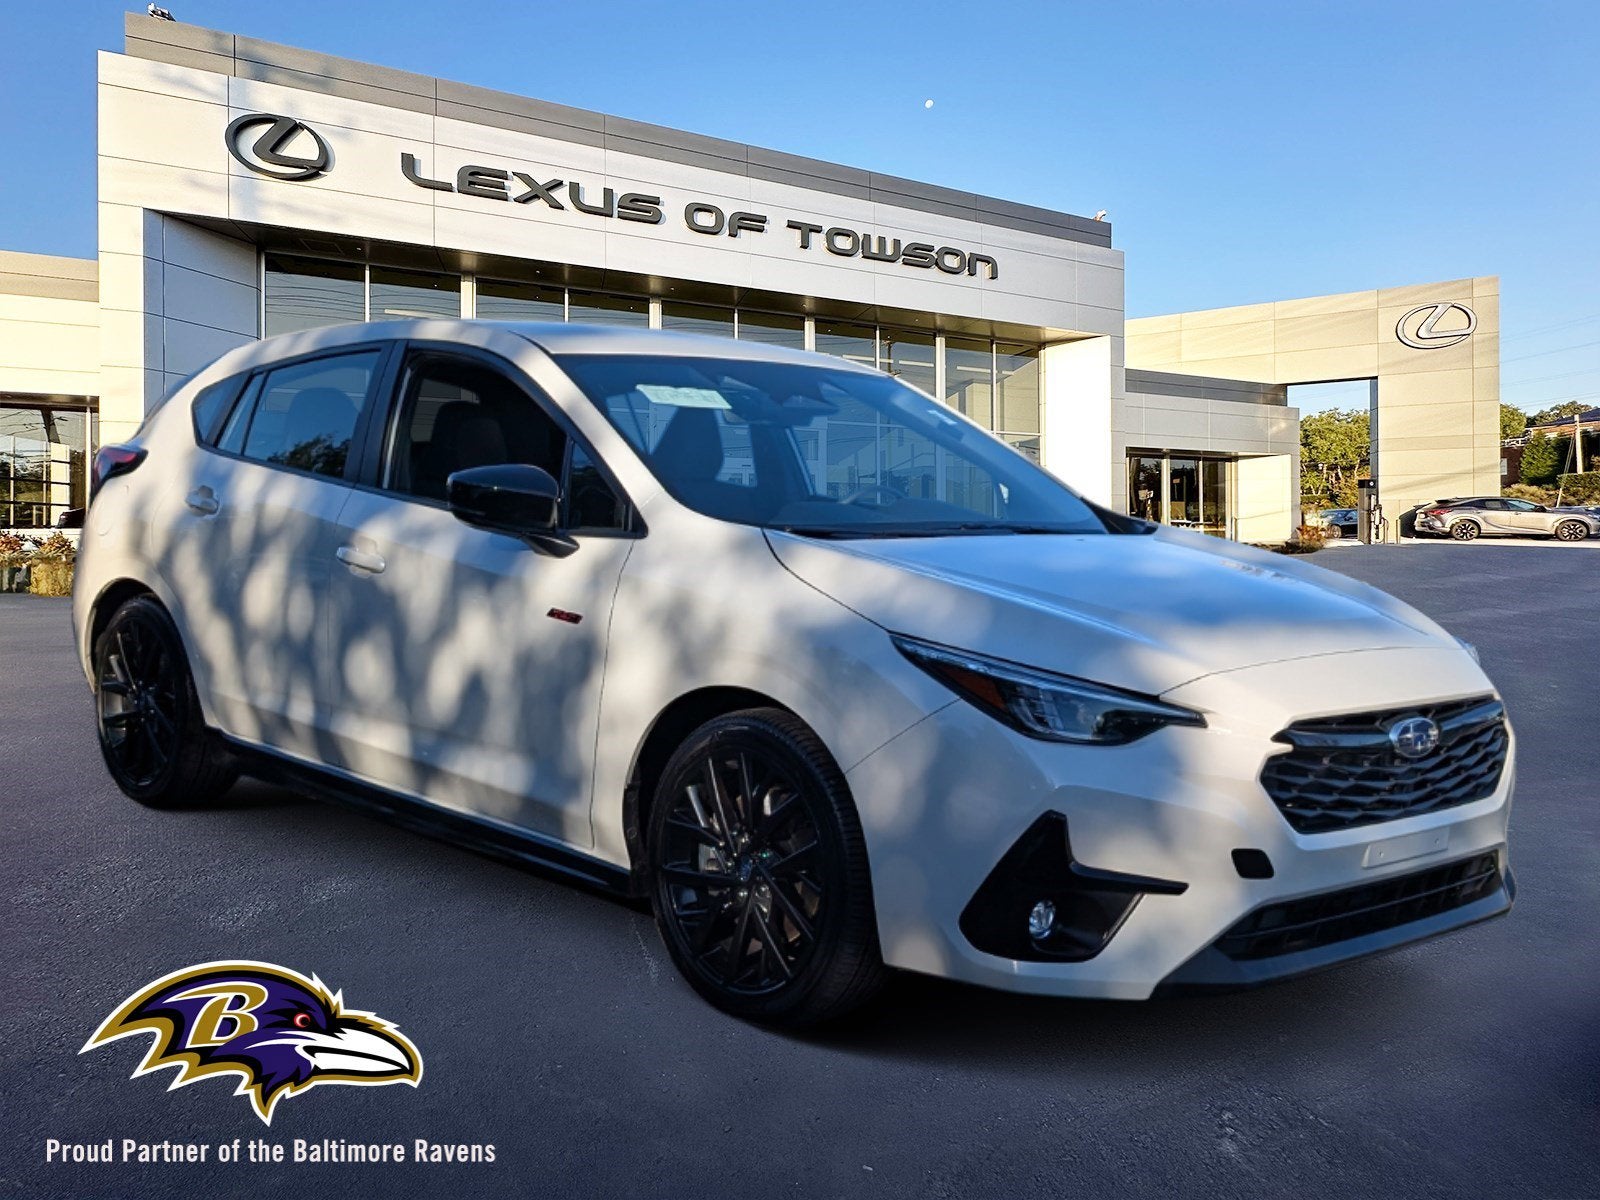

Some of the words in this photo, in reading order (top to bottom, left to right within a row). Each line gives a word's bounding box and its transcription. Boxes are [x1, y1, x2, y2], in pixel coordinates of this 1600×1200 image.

[401, 152, 661, 225] LEXUS
[684, 201, 767, 238] OF
[786, 219, 999, 280] TOWSON
